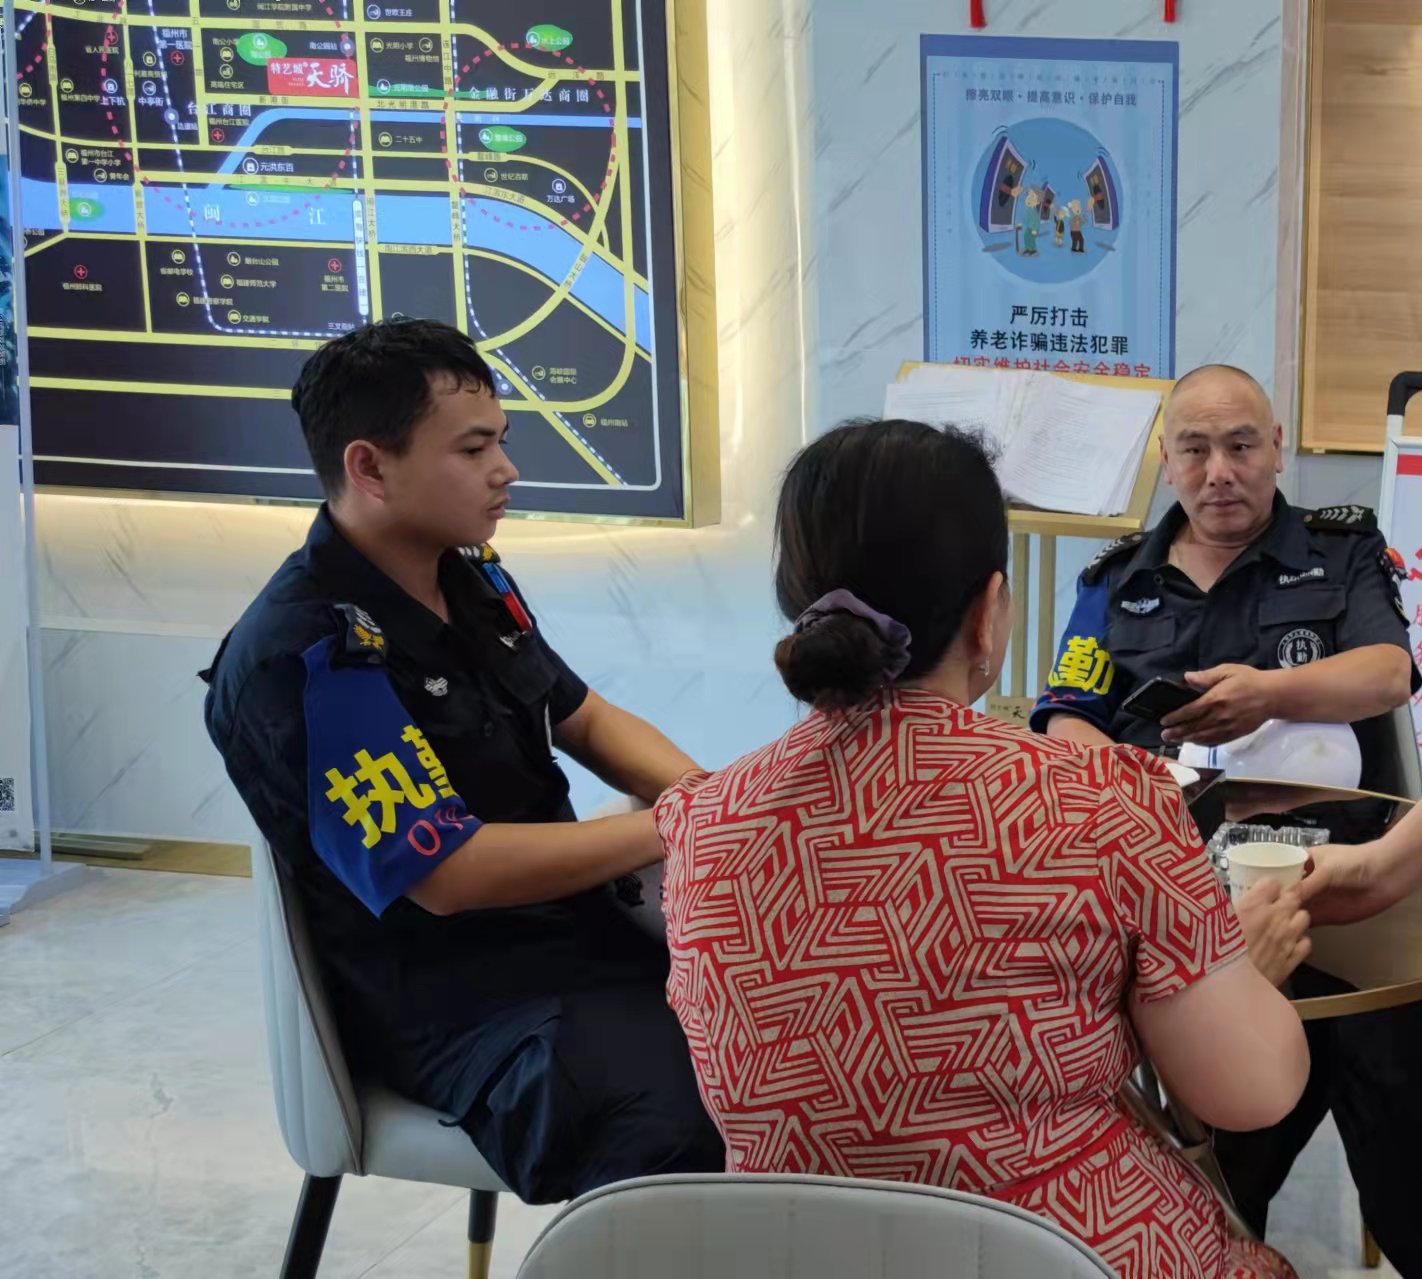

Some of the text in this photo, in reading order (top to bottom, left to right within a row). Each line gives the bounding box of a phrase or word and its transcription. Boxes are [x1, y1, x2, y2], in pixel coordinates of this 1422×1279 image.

[306, 61, 354, 95] 天骄
[468, 86, 590, 103] 金融街万达商圈
[187, 100, 252, 117] 台江商圈
[394, 135, 424, 144] 二十五中
[546, 194, 576, 204] 万达广场
[308, 206, 327, 225] 江
[1009, 305, 1089, 328] 严厉打击
[969, 329, 1129, 356] 养老诈骗违法犯罪
